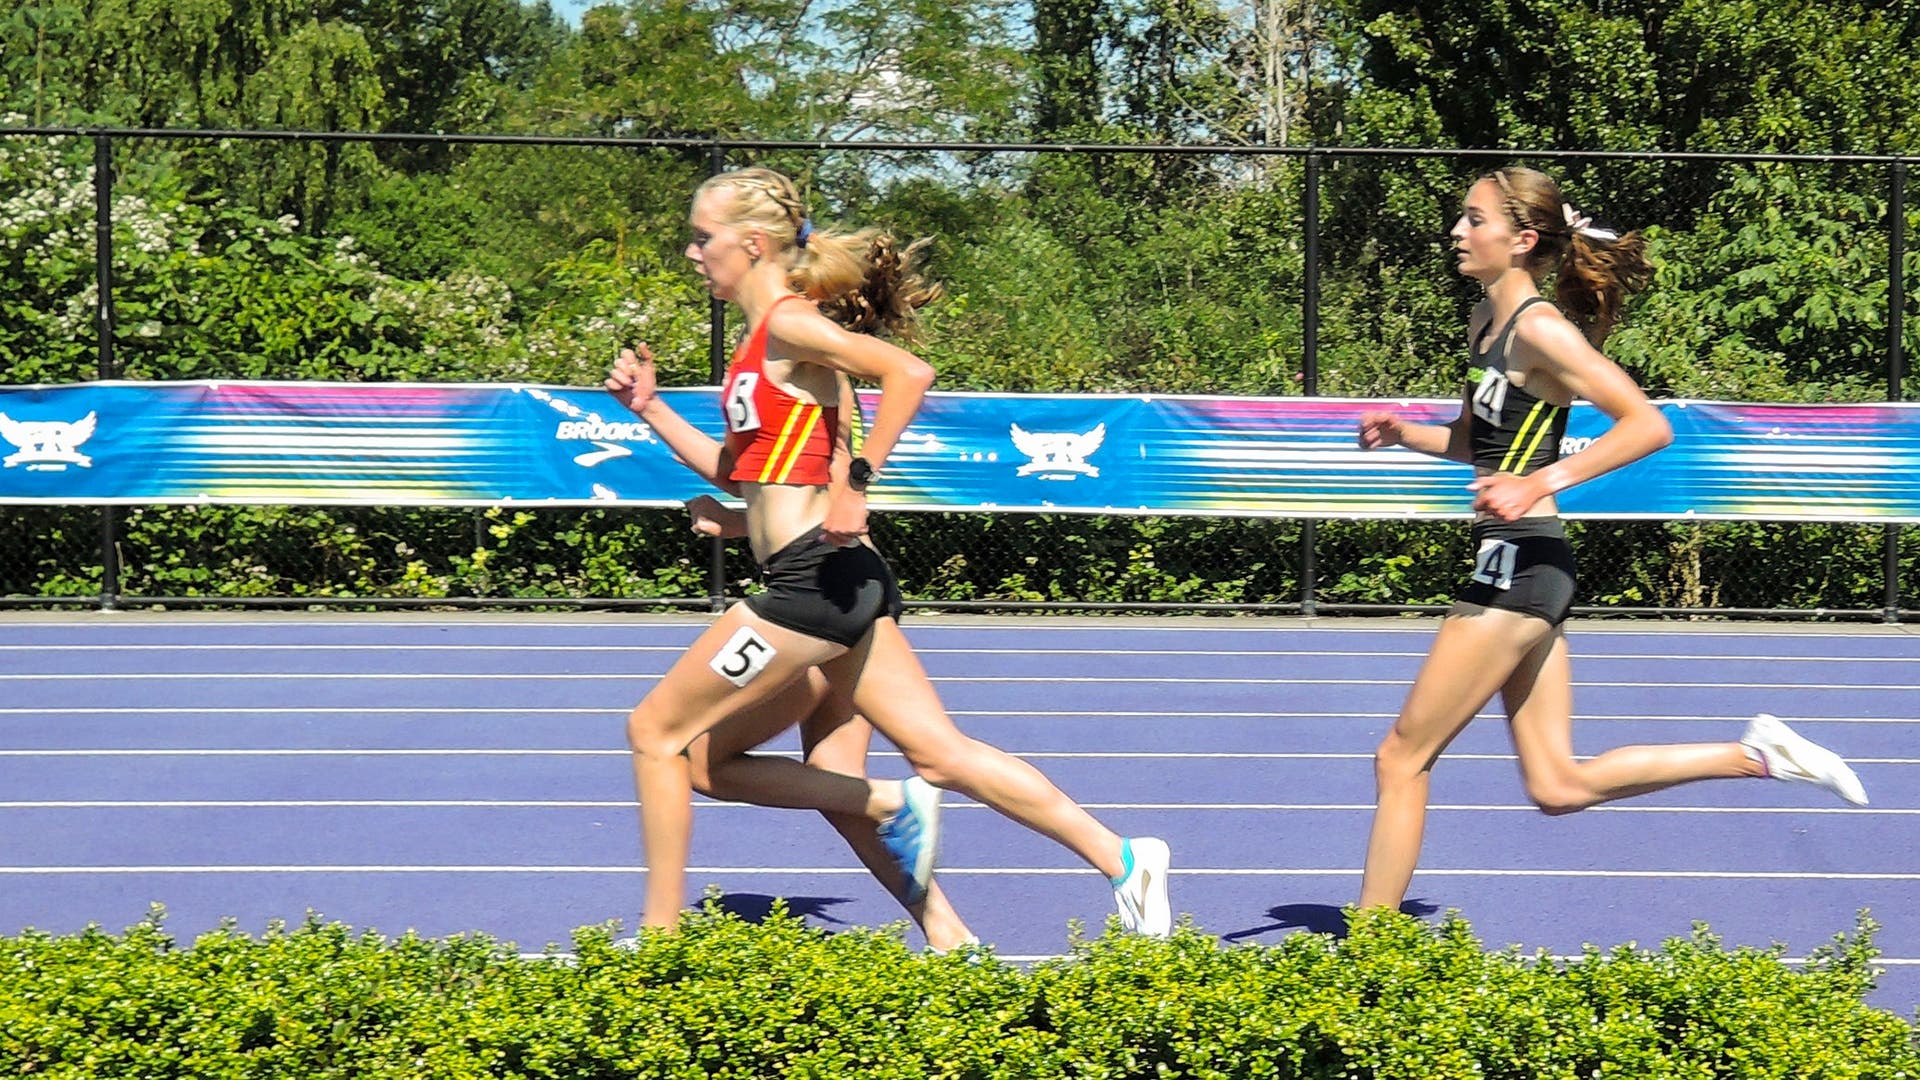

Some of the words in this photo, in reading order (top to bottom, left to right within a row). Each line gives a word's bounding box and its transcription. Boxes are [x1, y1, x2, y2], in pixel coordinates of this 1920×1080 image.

[1480, 377, 1499, 418] 4
[556, 421, 650, 441] BROOKS
[1479, 544, 1506, 586] 4
[721, 636, 767, 678] 5
